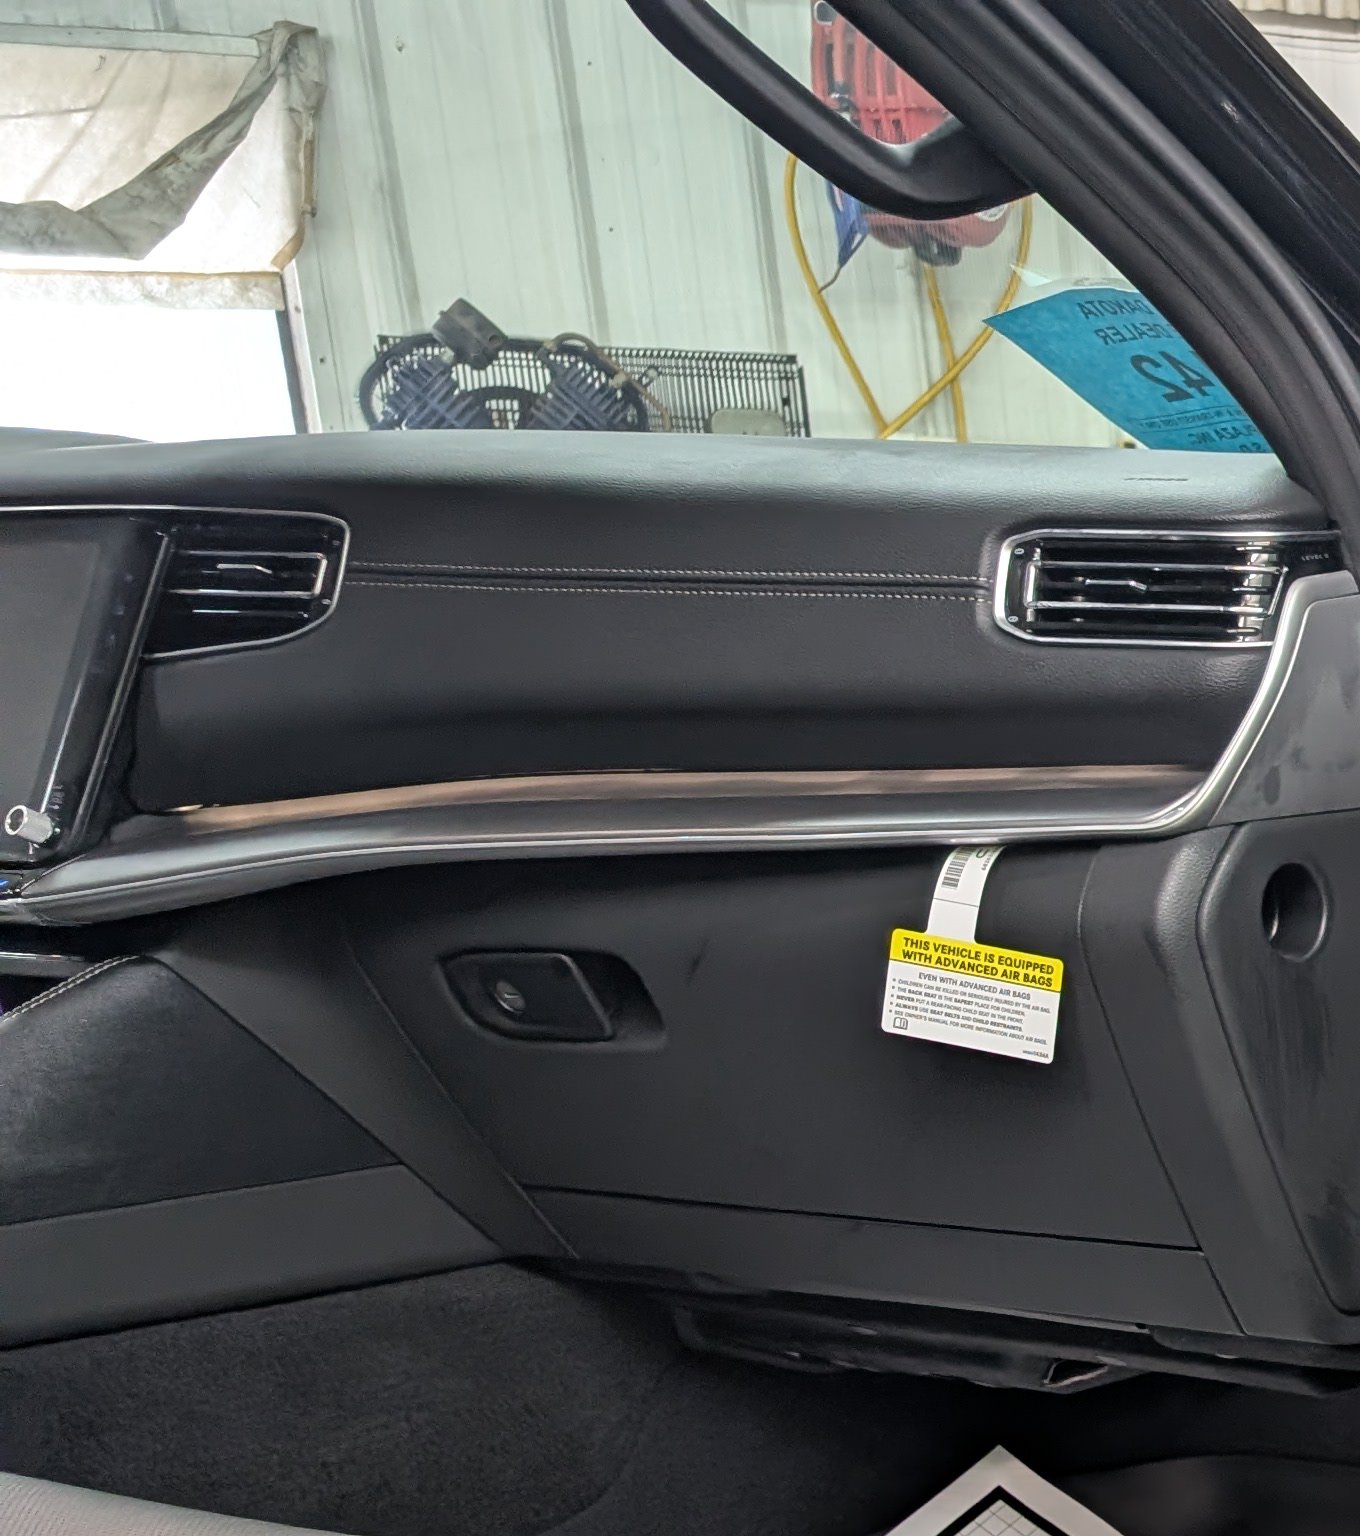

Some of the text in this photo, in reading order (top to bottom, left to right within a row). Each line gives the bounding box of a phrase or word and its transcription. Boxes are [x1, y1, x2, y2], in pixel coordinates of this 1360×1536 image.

[902, 949, 1053, 988] WITH ADVANCED AIR BAGS
[903, 937, 1055, 975] THIS VEHICLE IS EQUIPPED
[918, 972, 1031, 1001] EVEN WITH ADVANCED AIR BAGS
